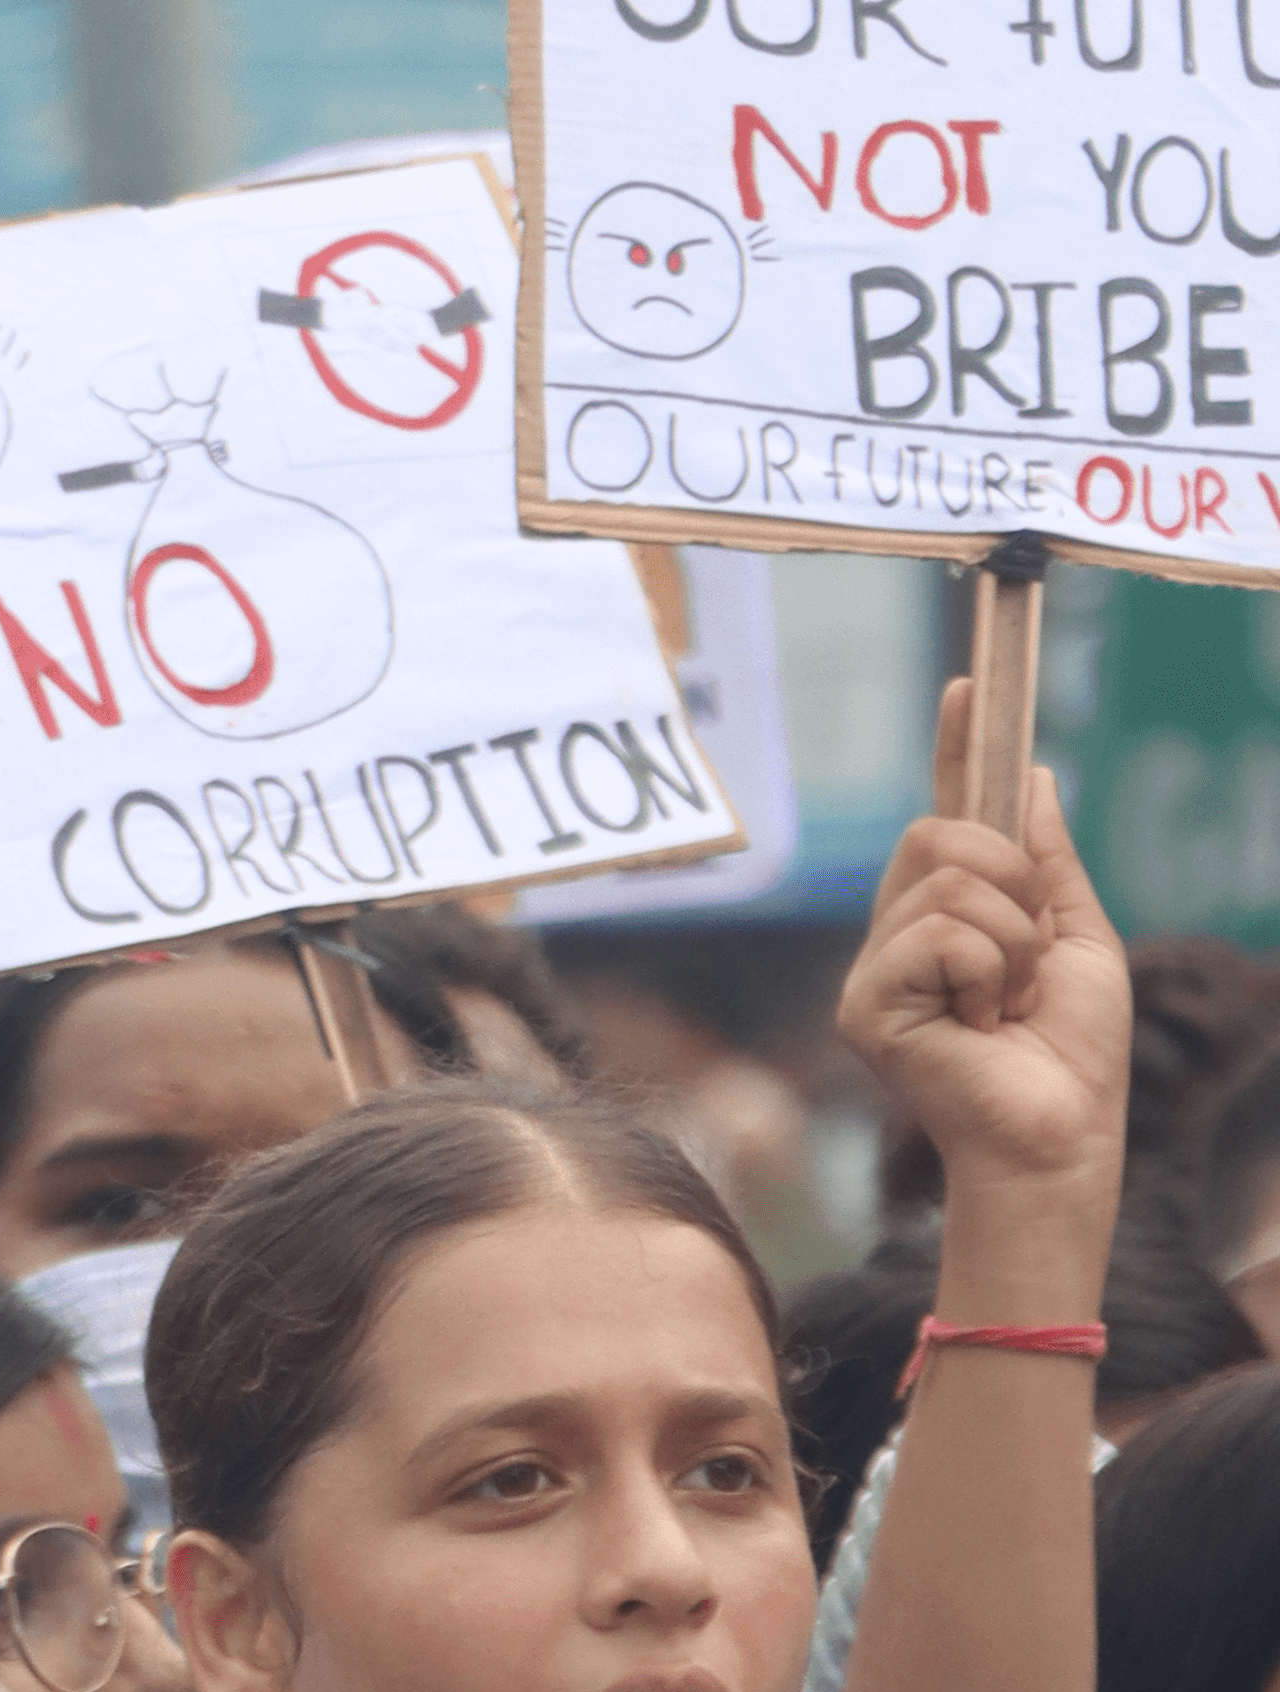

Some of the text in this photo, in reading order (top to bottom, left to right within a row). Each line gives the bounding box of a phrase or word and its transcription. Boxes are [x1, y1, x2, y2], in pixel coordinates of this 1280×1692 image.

[731, 103, 1002, 232] NOT
[850, 265, 1255, 436] BRIBE
[566, 399, 804, 504] OUR
[1075, 454, 1235, 540] OUR
[51, 715, 708, 924] CORRUPTION
